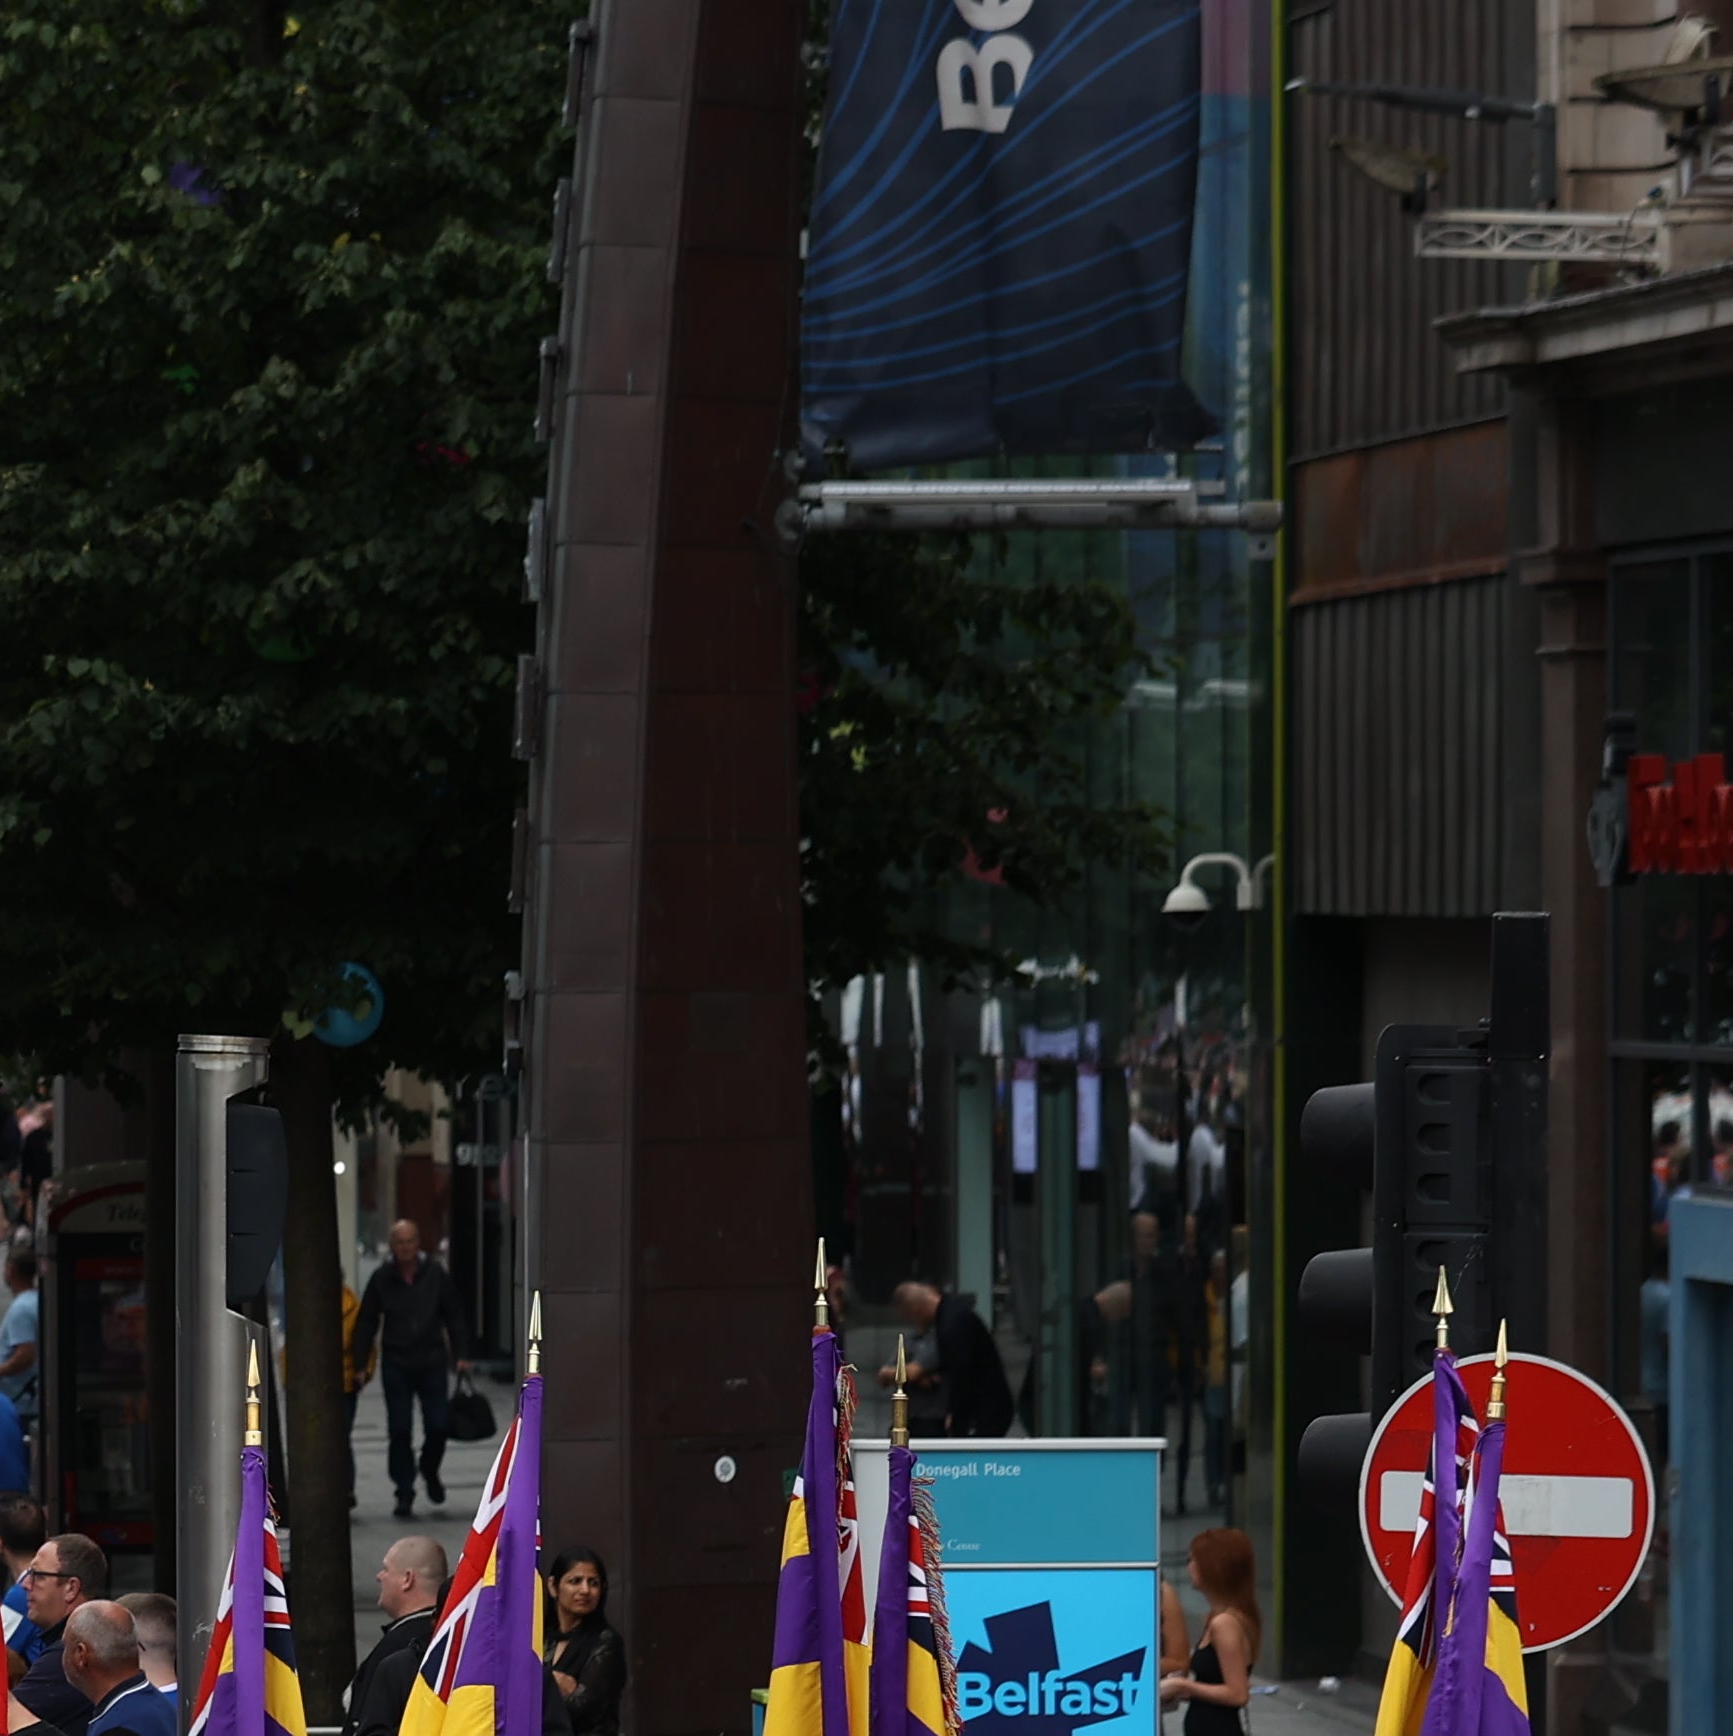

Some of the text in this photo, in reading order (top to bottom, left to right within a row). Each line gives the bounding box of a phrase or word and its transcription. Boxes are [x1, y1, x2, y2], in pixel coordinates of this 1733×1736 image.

[916, 1462, 1022, 1478] Donegall Place
[958, 1669, 1142, 1717] Belfast
